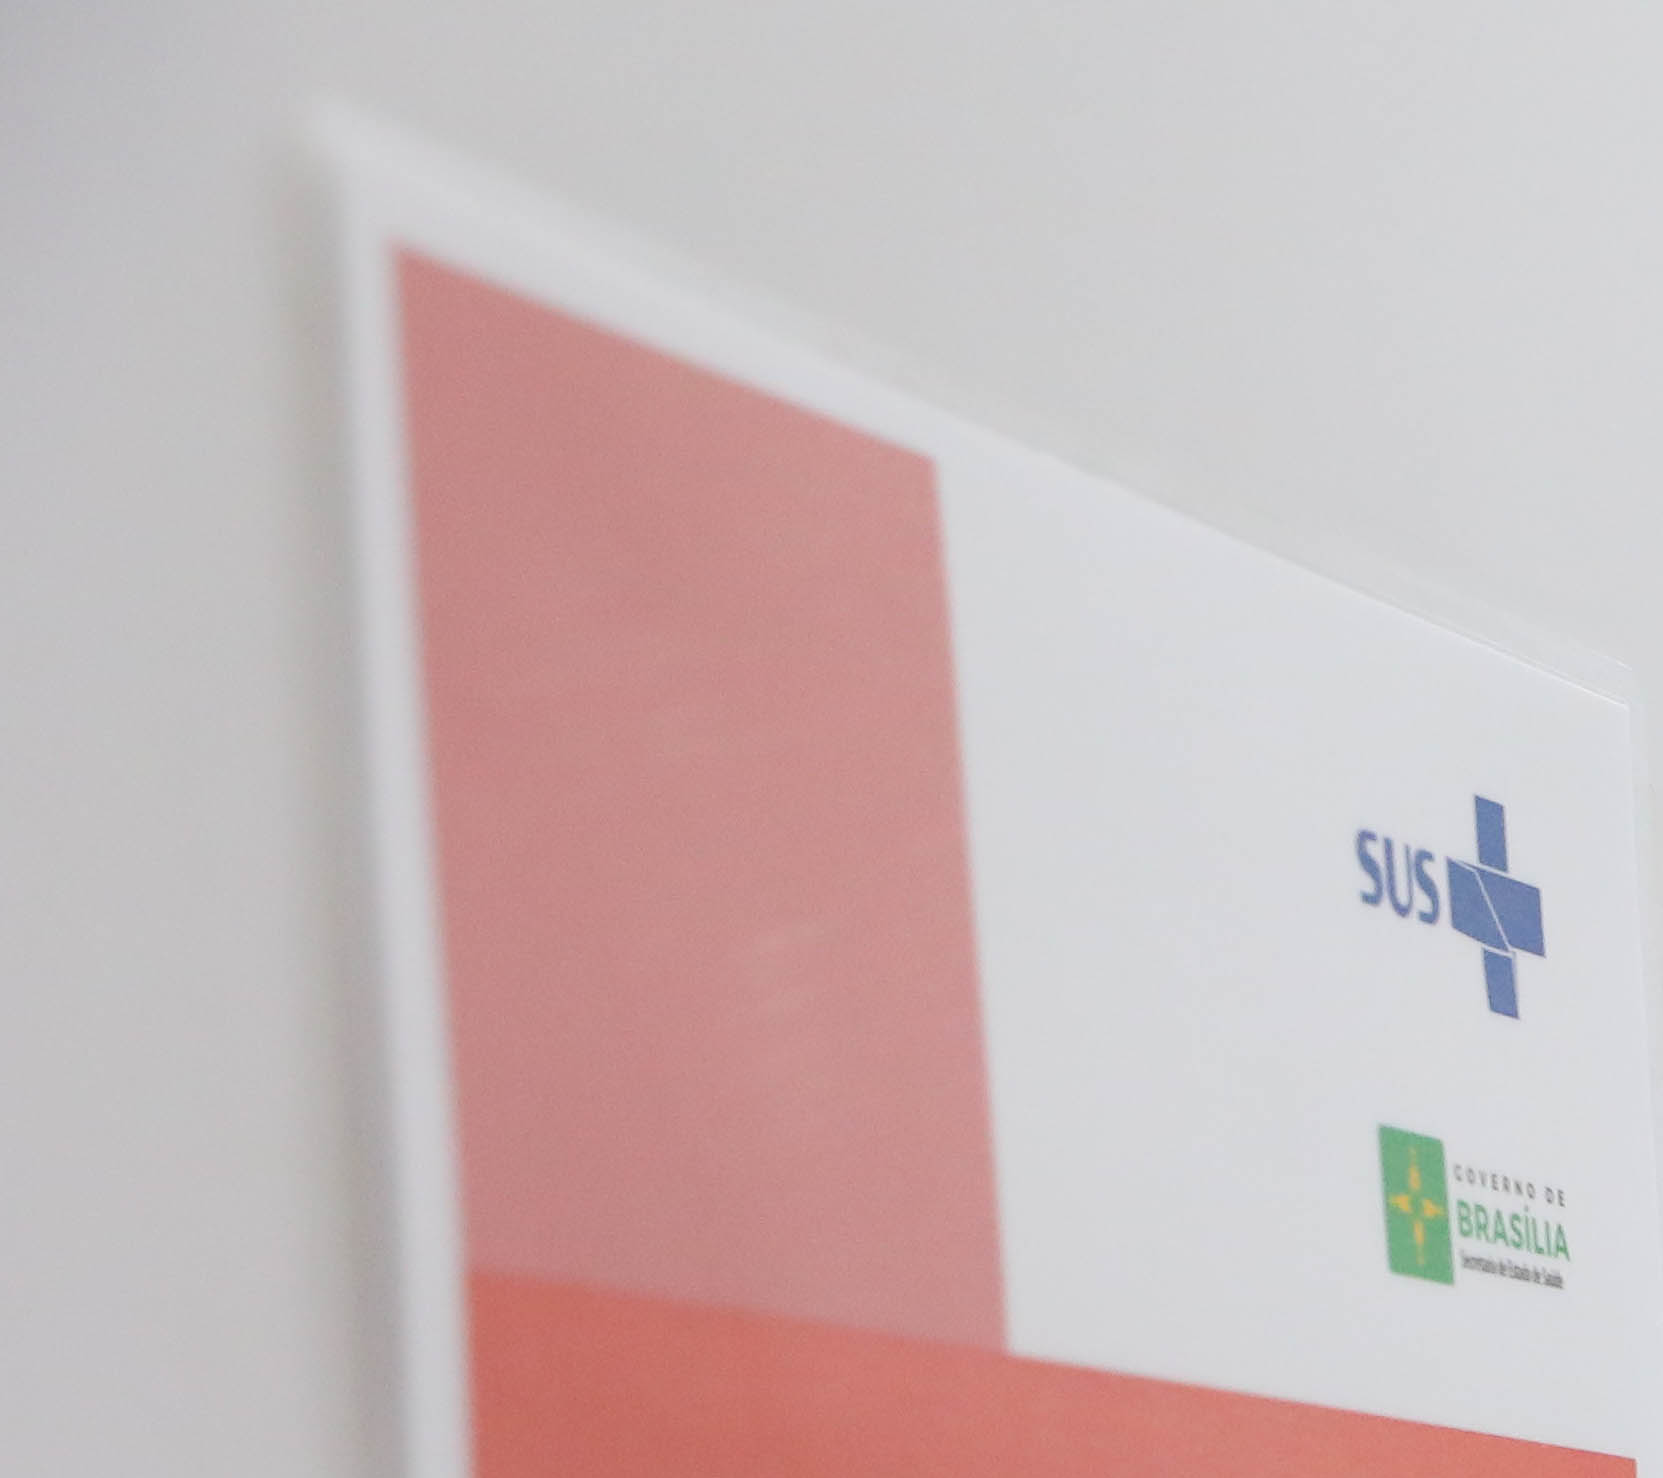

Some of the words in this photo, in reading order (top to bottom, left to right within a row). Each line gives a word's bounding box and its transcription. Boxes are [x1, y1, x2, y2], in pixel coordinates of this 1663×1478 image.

[1355, 828, 1440, 925] SUS
[1544, 1186, 1566, 1208] DE
[1456, 1199, 1570, 1261] BRASÍLIA
